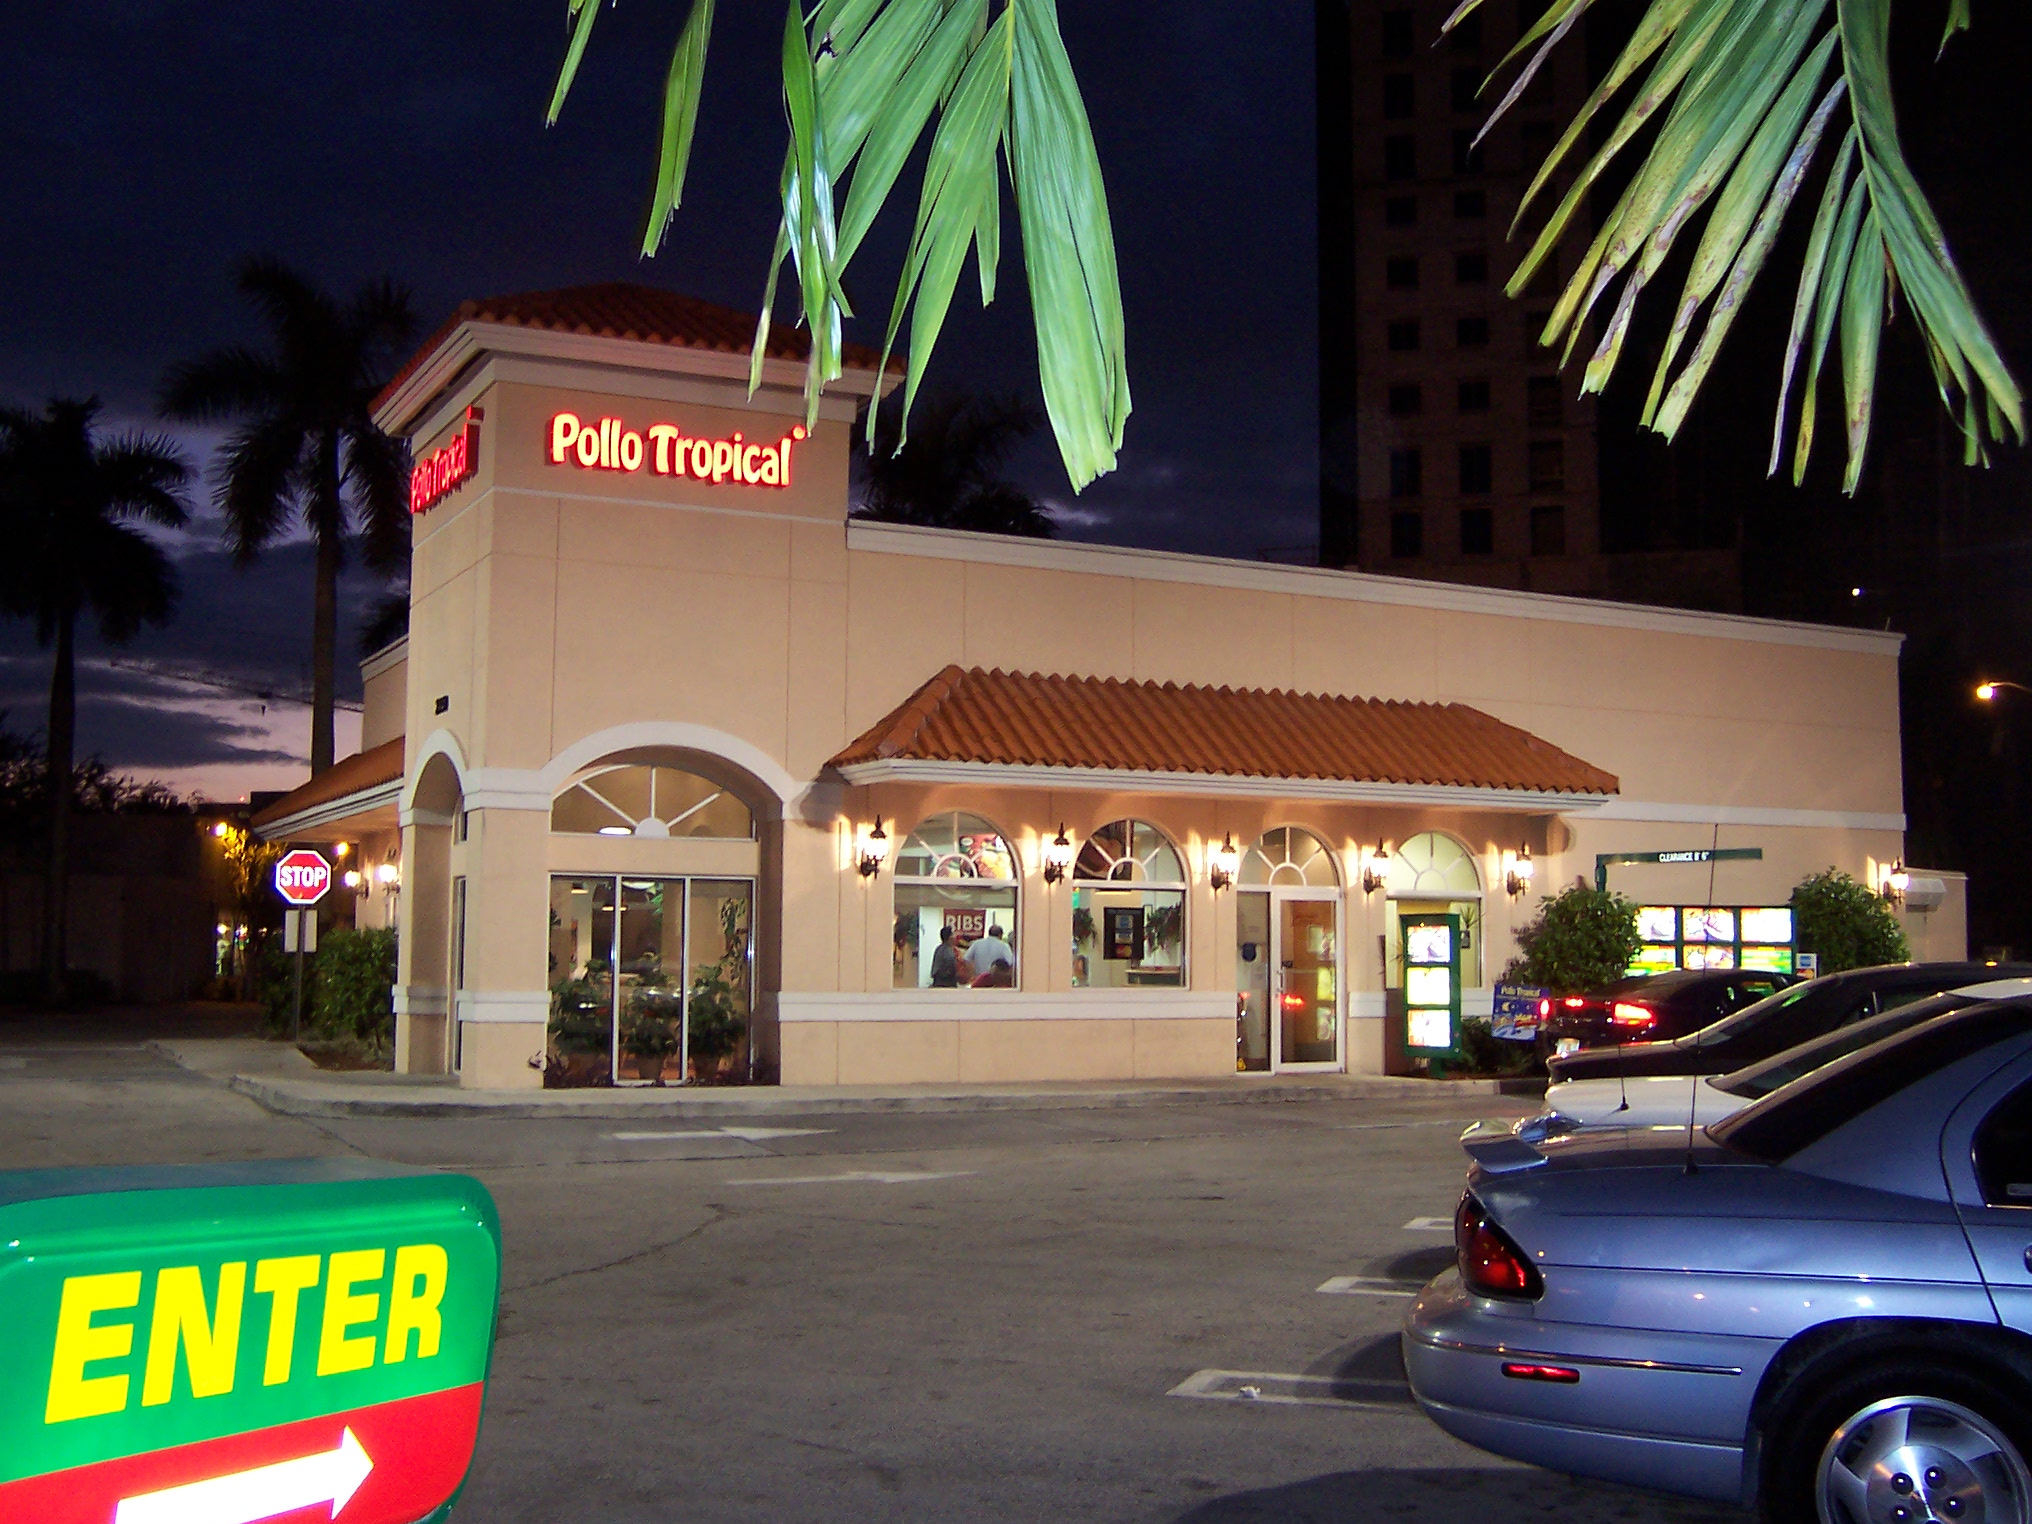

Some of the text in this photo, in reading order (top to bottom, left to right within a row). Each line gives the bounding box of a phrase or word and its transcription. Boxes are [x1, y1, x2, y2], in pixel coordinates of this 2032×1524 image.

[551, 411, 791, 487] Pollo Tropical
[1658, 851, 1694, 862] CLEARANCE
[280, 866, 327, 888] STOP
[945, 913, 984, 932] RIBS
[44, 1244, 449, 1425] ENTER
